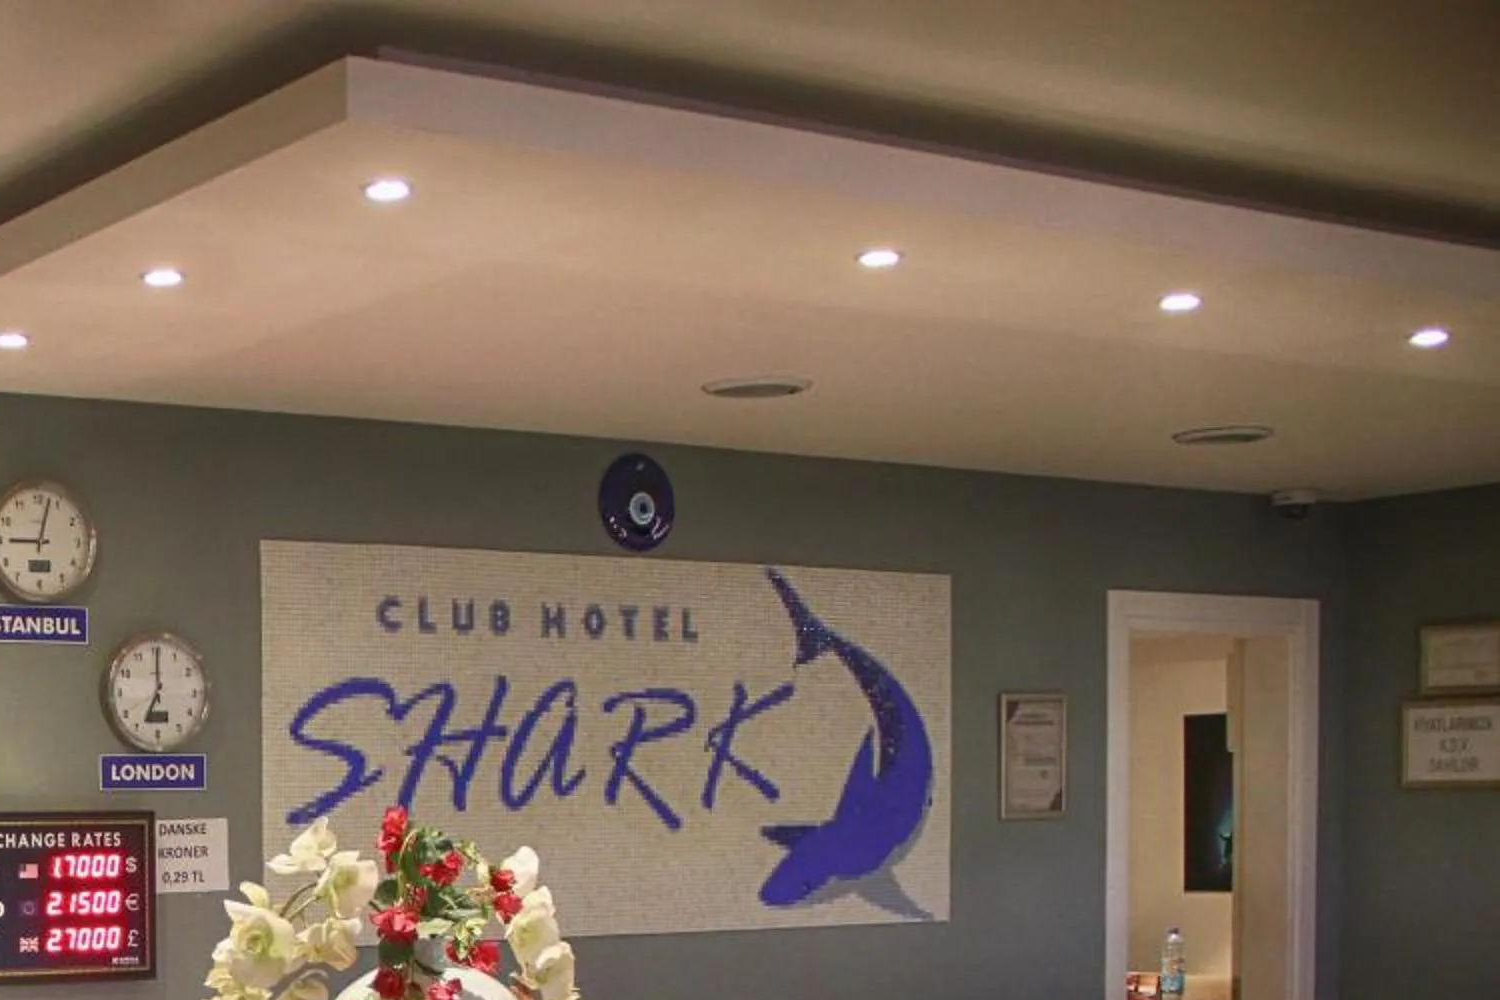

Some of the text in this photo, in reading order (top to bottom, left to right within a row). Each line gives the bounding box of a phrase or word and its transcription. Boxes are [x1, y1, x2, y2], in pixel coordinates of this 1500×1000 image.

[376, 596, 699, 643] CLUB HOTEL
[285, 674, 795, 831] SHARK
[111, 763, 196, 781] LONDON
[71, 831, 121, 848] RATES
[159, 822, 207, 836] DANSKE
[158, 845, 209, 859] KRONER
[53, 854, 121, 879] 17000
[162, 871, 188, 886] 0,29
[46, 890, 121, 916] 21500
[46, 927, 121, 952] 27000
